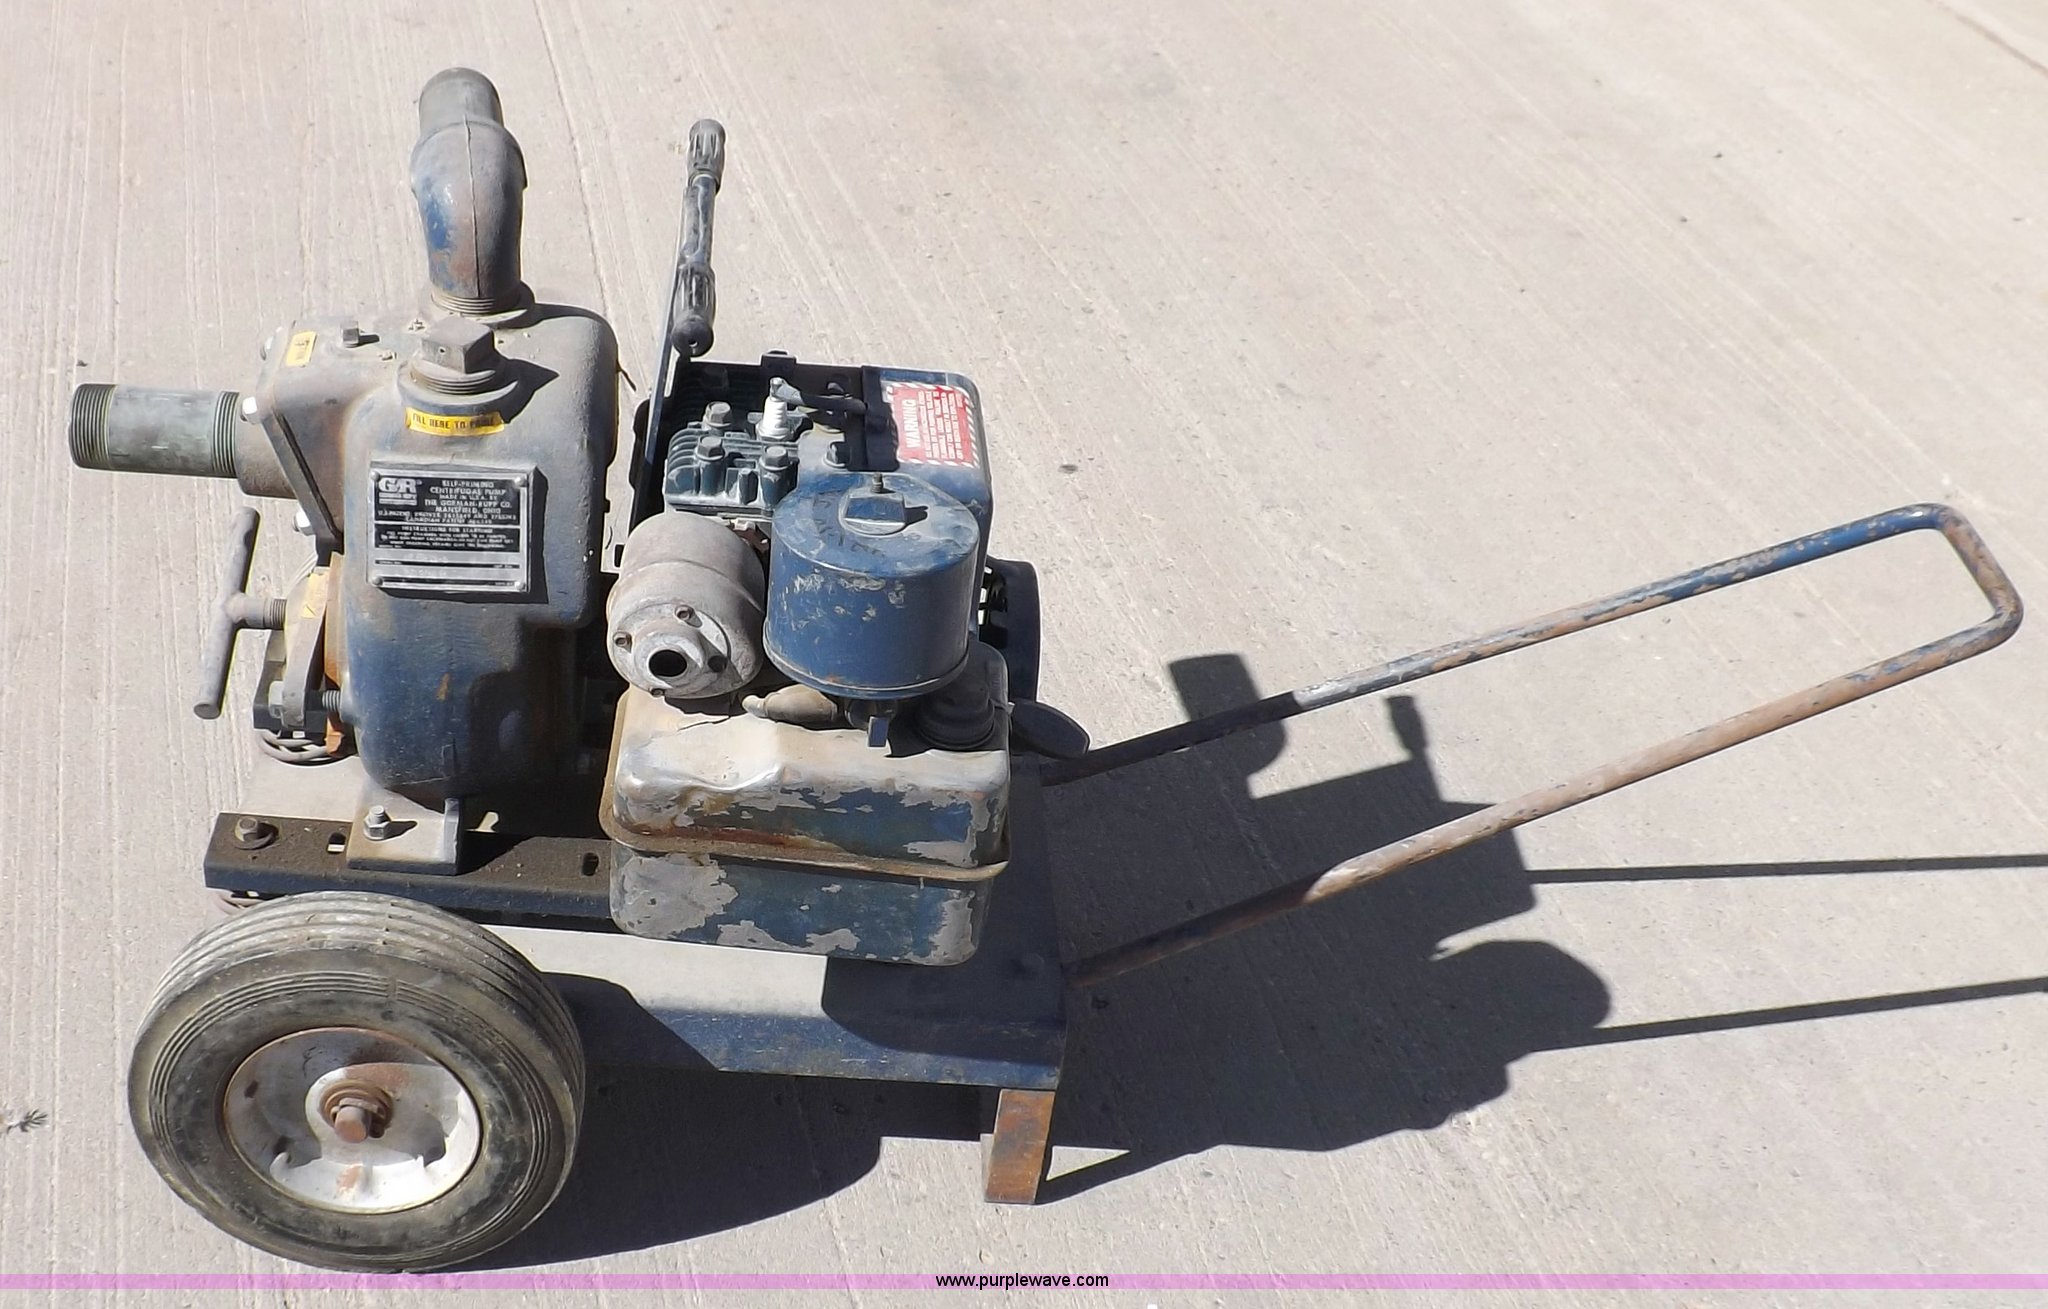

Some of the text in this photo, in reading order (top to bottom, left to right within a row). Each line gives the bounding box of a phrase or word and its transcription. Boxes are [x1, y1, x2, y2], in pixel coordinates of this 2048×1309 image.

[429, 418, 450, 429] HERE
[455, 420, 466, 429] TO
[902, 399, 921, 448] WARNING
[440, 500, 498, 508] GORMAN-RUPP
